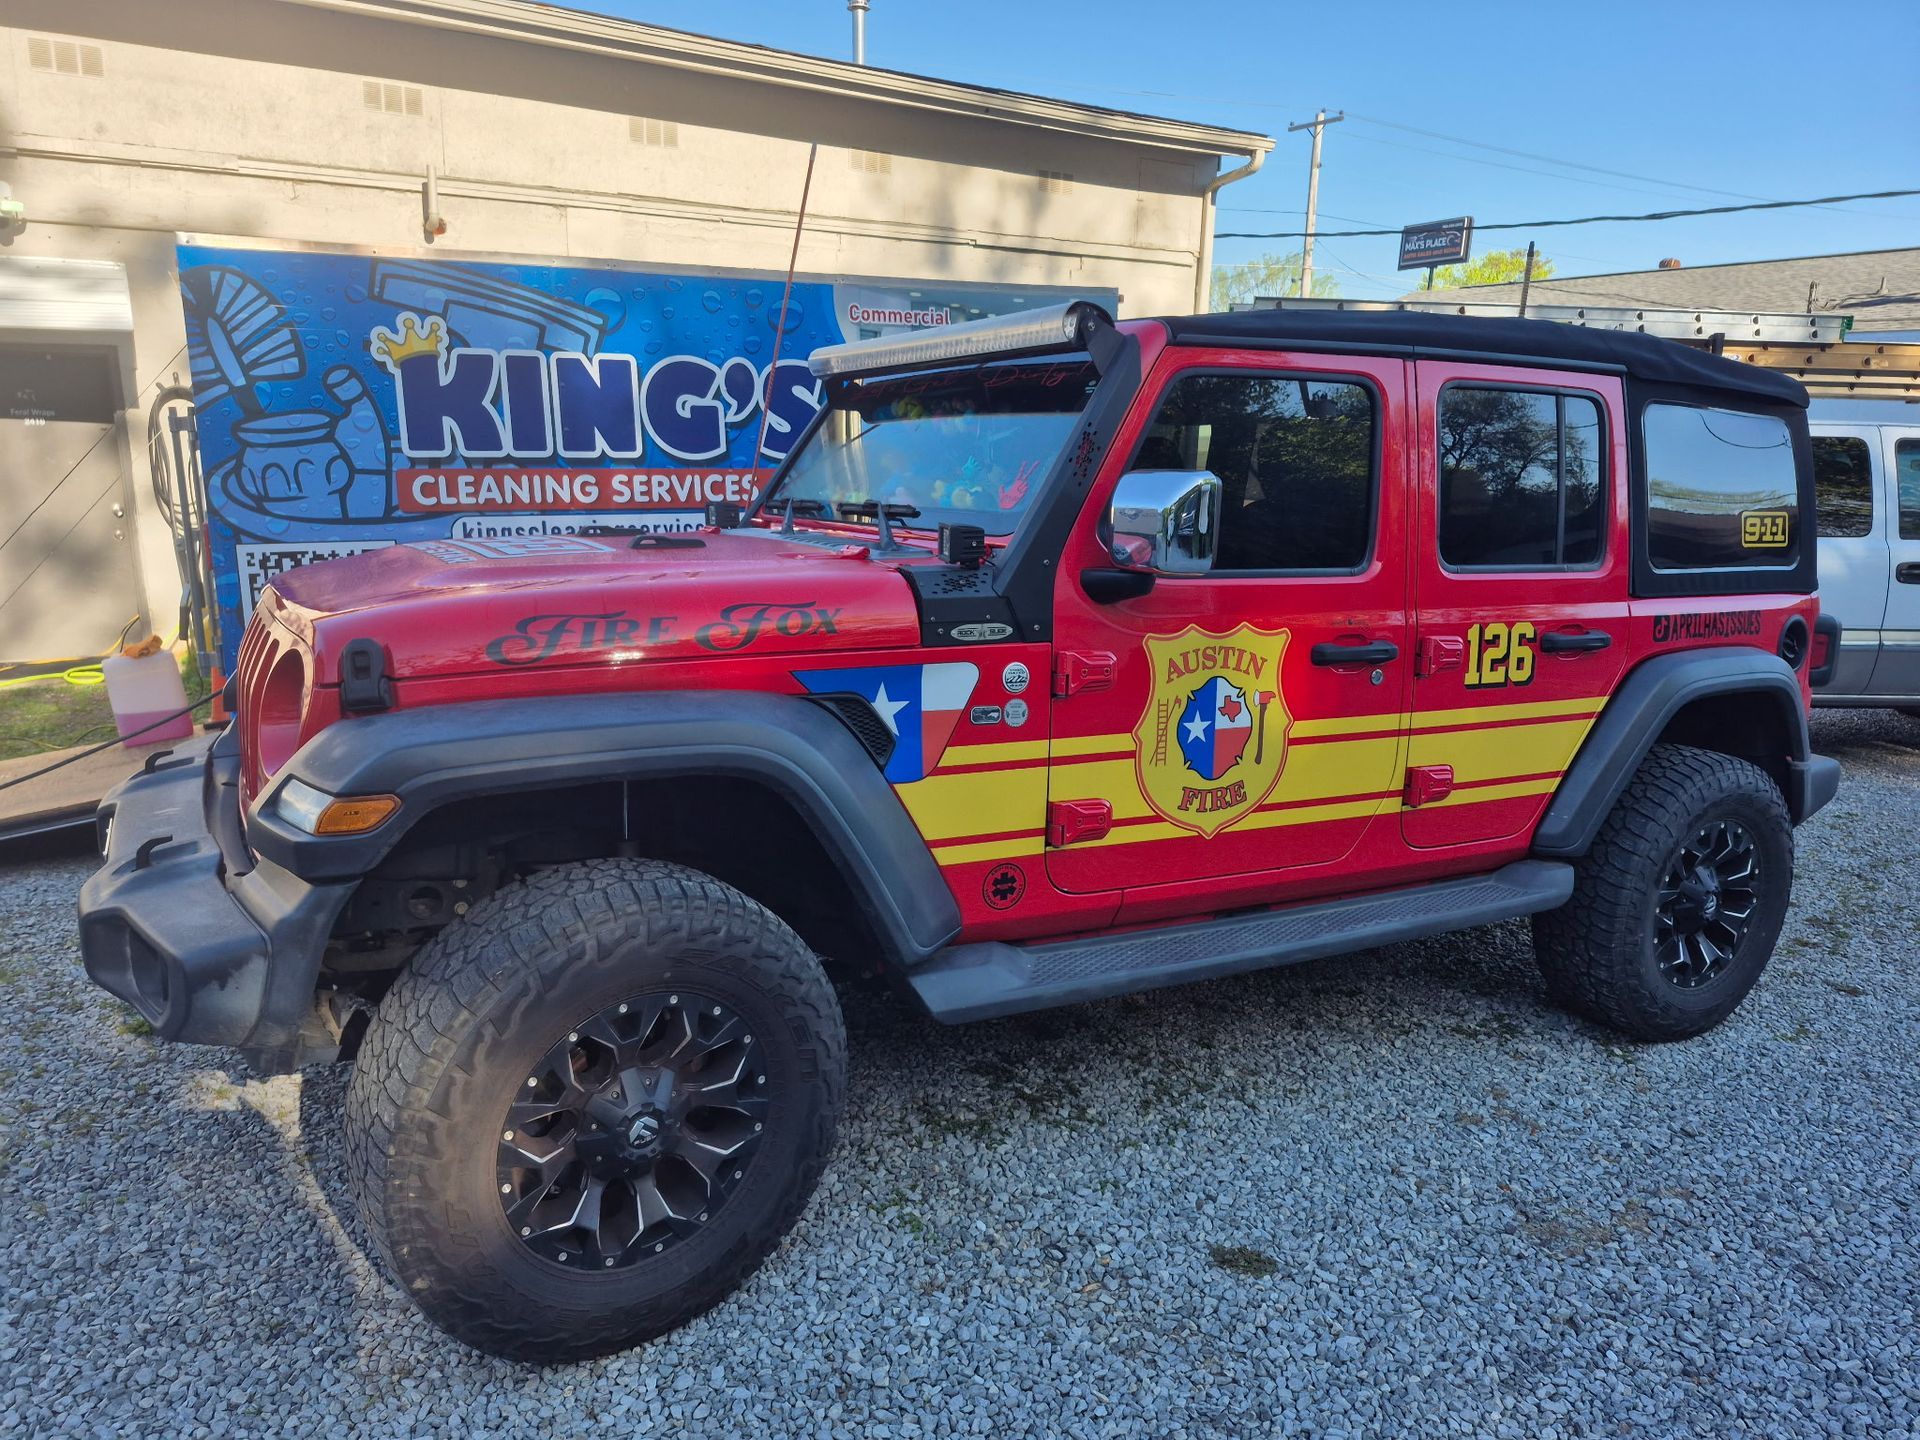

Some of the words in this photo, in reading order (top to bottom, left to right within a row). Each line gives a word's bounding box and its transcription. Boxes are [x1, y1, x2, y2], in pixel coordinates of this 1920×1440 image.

[1426, 237, 1447, 249] PLACE
[849, 304, 951, 326] Commercial
[399, 348, 823, 461] KING'S
[411, 474, 599, 506] CLEANING
[611, 471, 760, 504] SERVICES
[1166, 646, 1268, 684] AUSTIN
[1463, 621, 1538, 690] 126
[1177, 780, 1248, 813] FIRE
